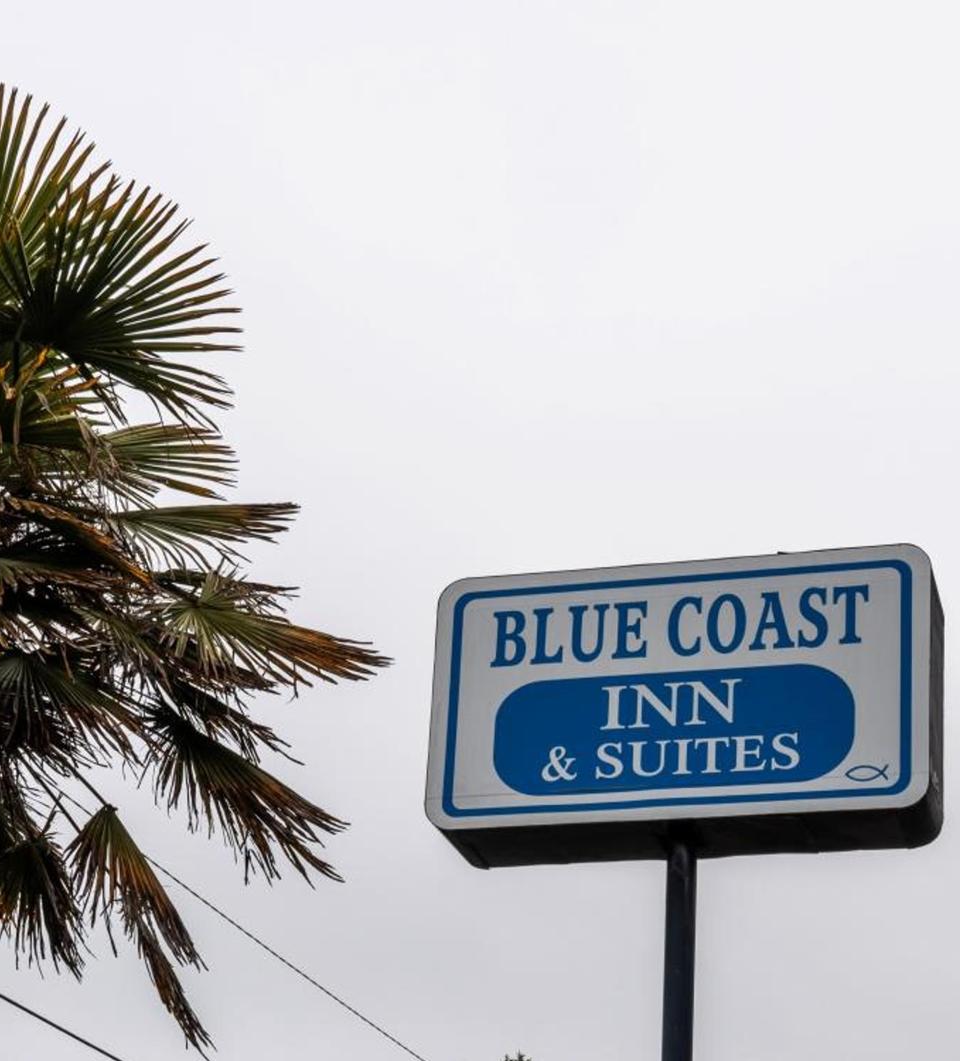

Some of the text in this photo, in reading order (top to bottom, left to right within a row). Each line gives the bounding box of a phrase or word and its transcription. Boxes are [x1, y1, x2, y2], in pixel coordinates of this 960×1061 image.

[490, 584, 869, 668] BLUE COAST
[600, 678, 742, 731] INN
[542, 732, 801, 782] & SUITES
